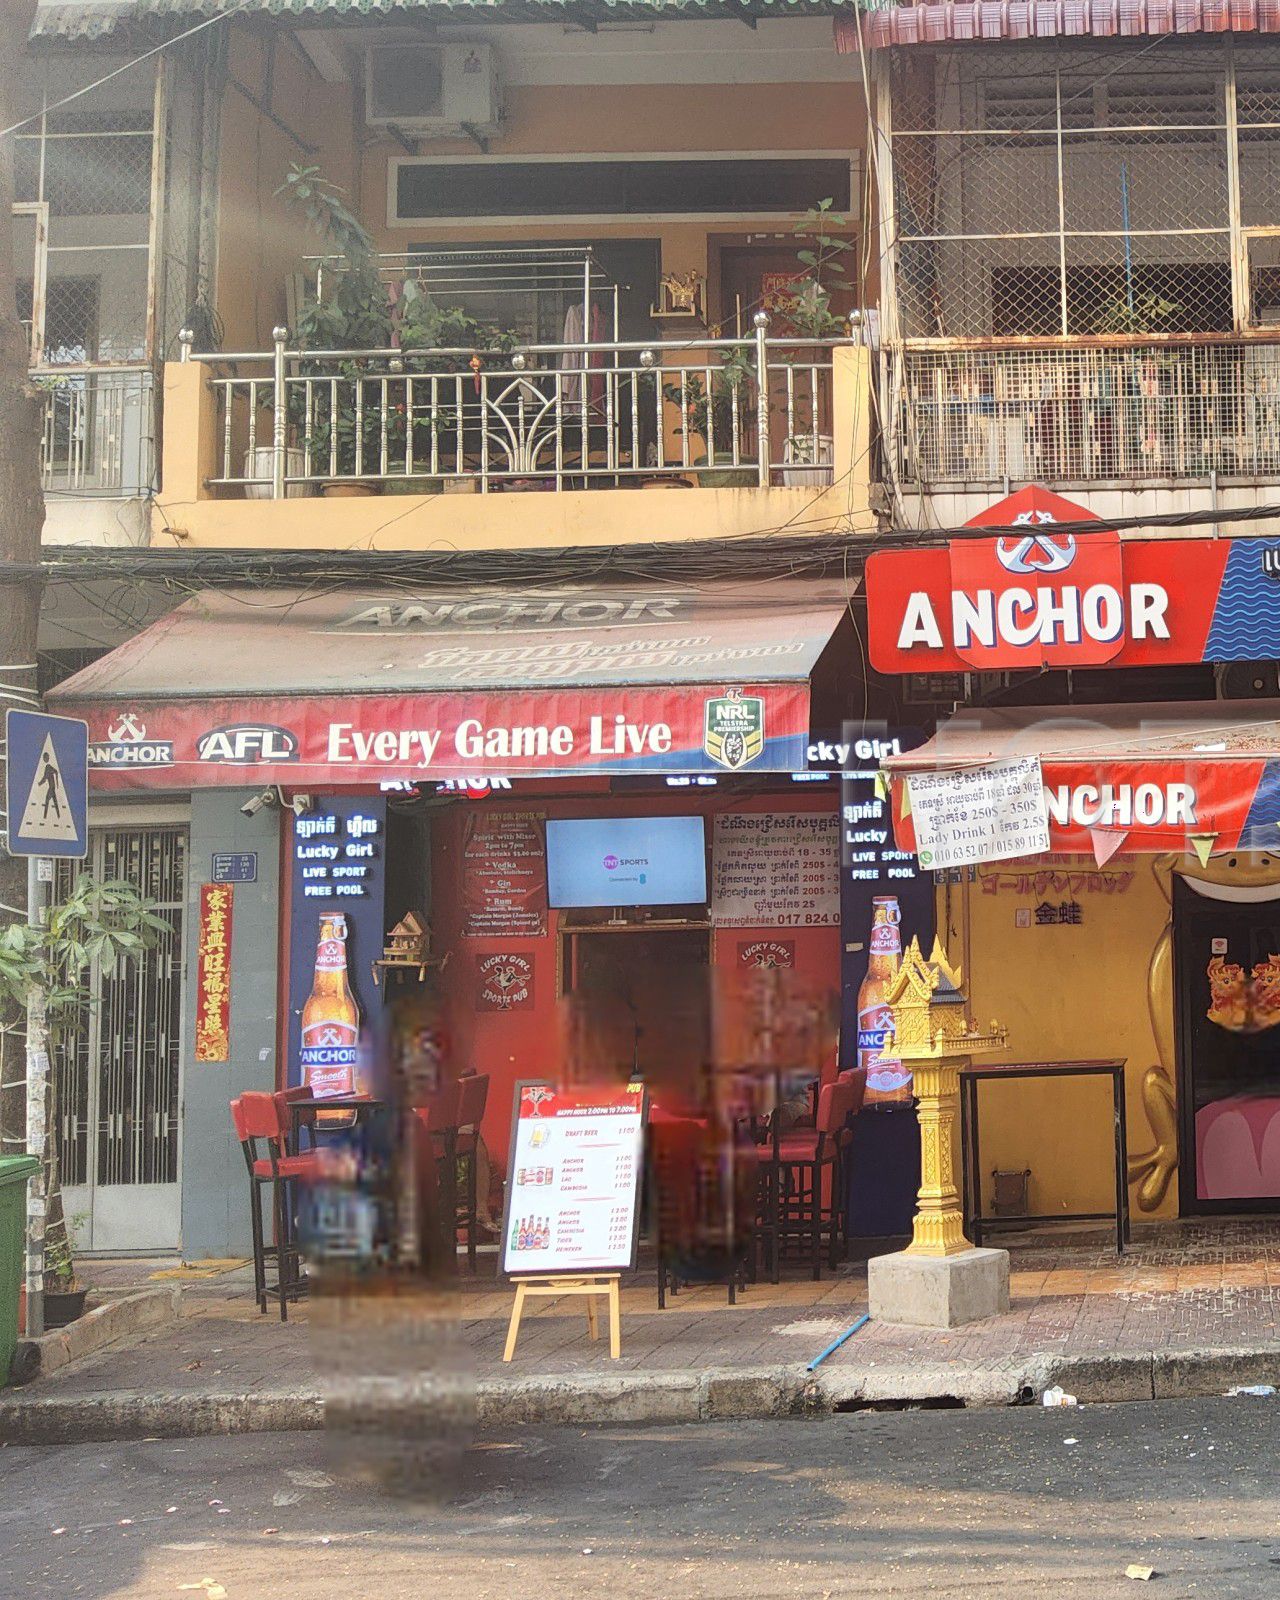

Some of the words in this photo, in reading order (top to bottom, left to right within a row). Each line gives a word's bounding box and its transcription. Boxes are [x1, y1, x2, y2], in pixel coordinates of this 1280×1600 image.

[340, 597, 682, 629] ANCHOR
[897, 583, 1170, 649] ANCHOR
[716, 704, 755, 720] NRL
[200, 730, 290, 759] AFL
[328, 723, 440, 768] Every
[454, 719, 574, 758] Game
[588, 715, 672, 754] Live
[806, 741, 850, 766] cky
[855, 737, 900, 761] Girl
[1044, 783, 1199, 827] NCHOR
[473, 833, 494, 841] Spirit
[846, 829, 888, 844] Lucky
[919, 832, 949, 846] Lady
[952, 826, 986, 841] Drink
[990, 823, 996, 835] 1
[297, 844, 339, 860] Lucky
[345, 843, 374, 857] Girl
[852, 851, 876, 862] LIVE
[881, 850, 914, 861] SPORT
[934, 849, 951, 861] 010
[953, 847, 963, 859] 63
[966, 846, 976, 857] 52
[978, 844, 988, 855] 07
[996, 839, 1013, 852] 015
[1015, 837, 1025, 849] 89
[303, 867, 327, 878] LIVE
[332, 866, 367, 877] SPORT
[852, 868, 879, 880] FREE
[888, 867, 916, 878] POOL
[304, 886, 332, 896] FREE
[336, 884, 364, 895] POOL
[778, 913, 801, 925] 017
[805, 913, 828, 924] 824
[1034, 901, 1083, 925] 金蛙
[741, 942, 768, 961] LUCKY
[769, 943, 791, 959] GIRL
[871, 939, 900, 948] ANCHOR
[317, 955, 347, 964] ANCHOR
[480, 954, 508, 973] LUCKY
[509, 955, 531, 972] GIRL
[481, 988, 511, 1003] SPORTS
[512, 987, 528, 1002] PUB
[859, 1033, 883, 1047] ANC
[302, 1049, 357, 1064] ANCHOR
[309, 1067, 349, 1085] Smooth
[626, 1083, 642, 1094] PUB
